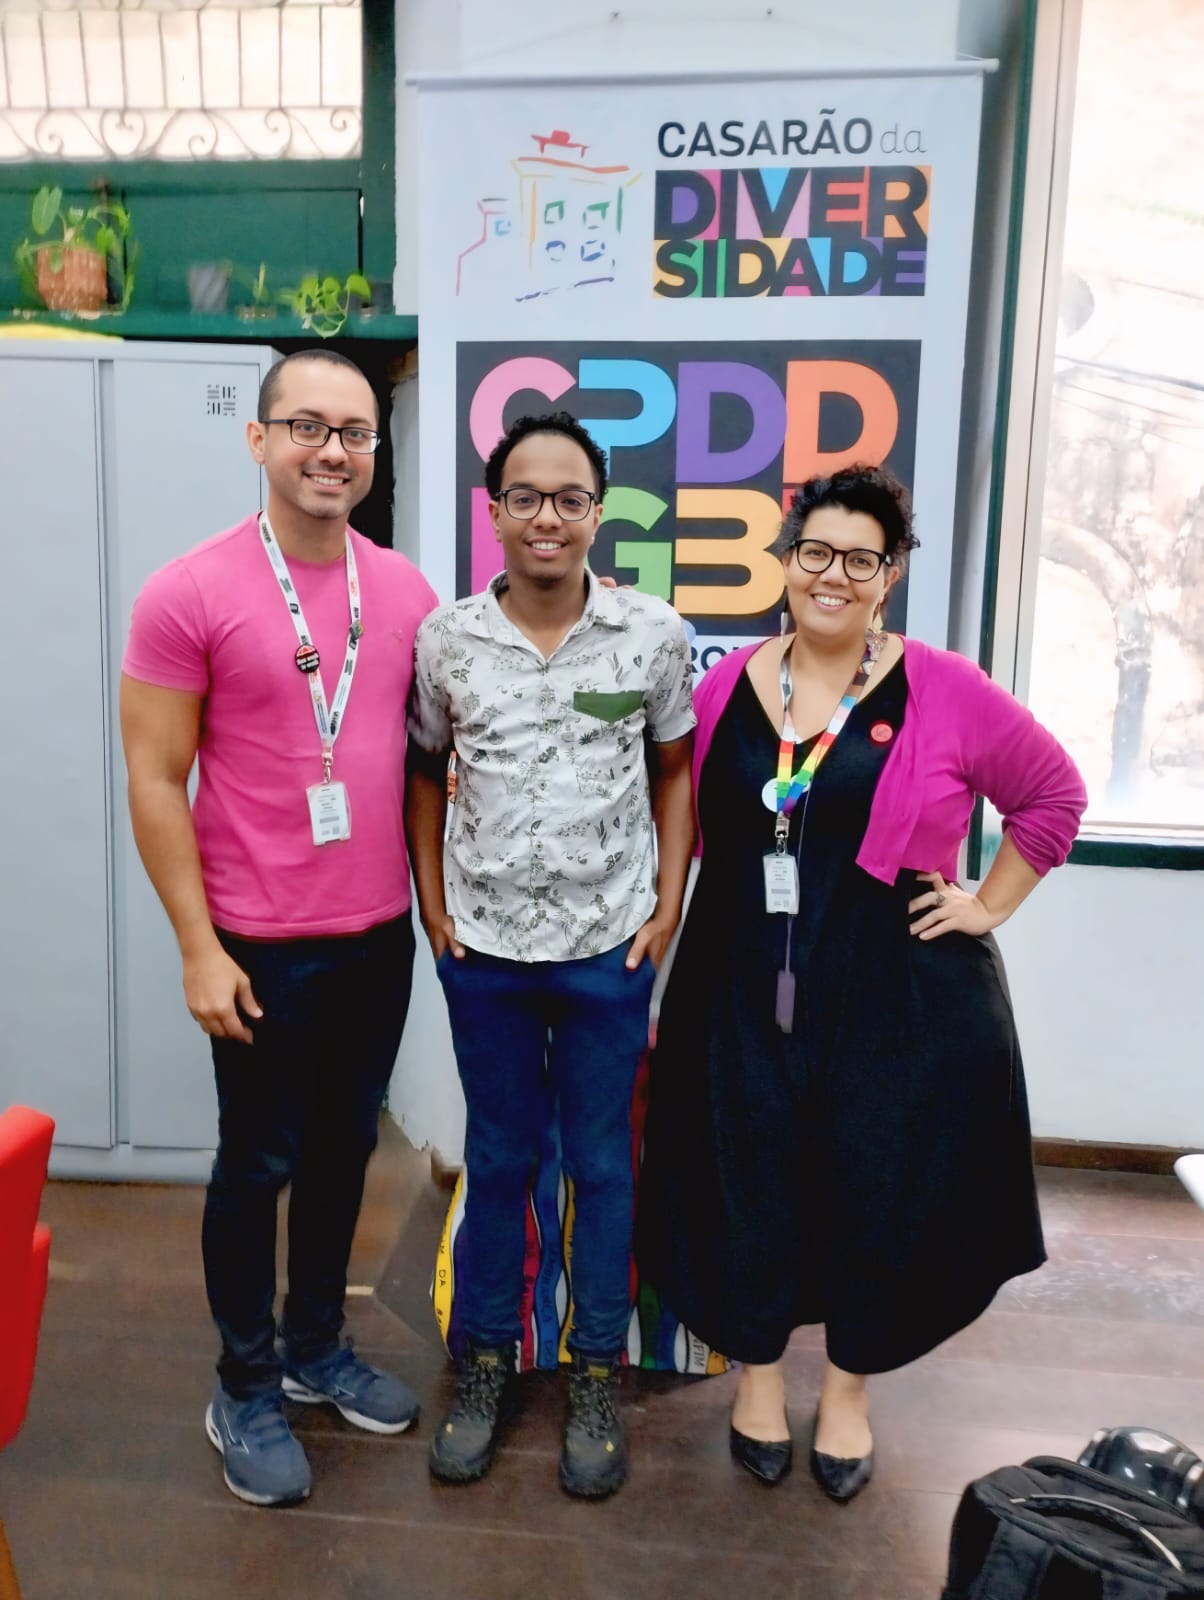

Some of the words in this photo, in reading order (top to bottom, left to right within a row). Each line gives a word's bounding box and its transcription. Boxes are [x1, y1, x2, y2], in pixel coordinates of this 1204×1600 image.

[657, 108, 873, 158] CASARÃO
[879, 122, 927, 154] da
[653, 165, 929, 241] DIVER
[653, 236, 928, 298] SIDADE
